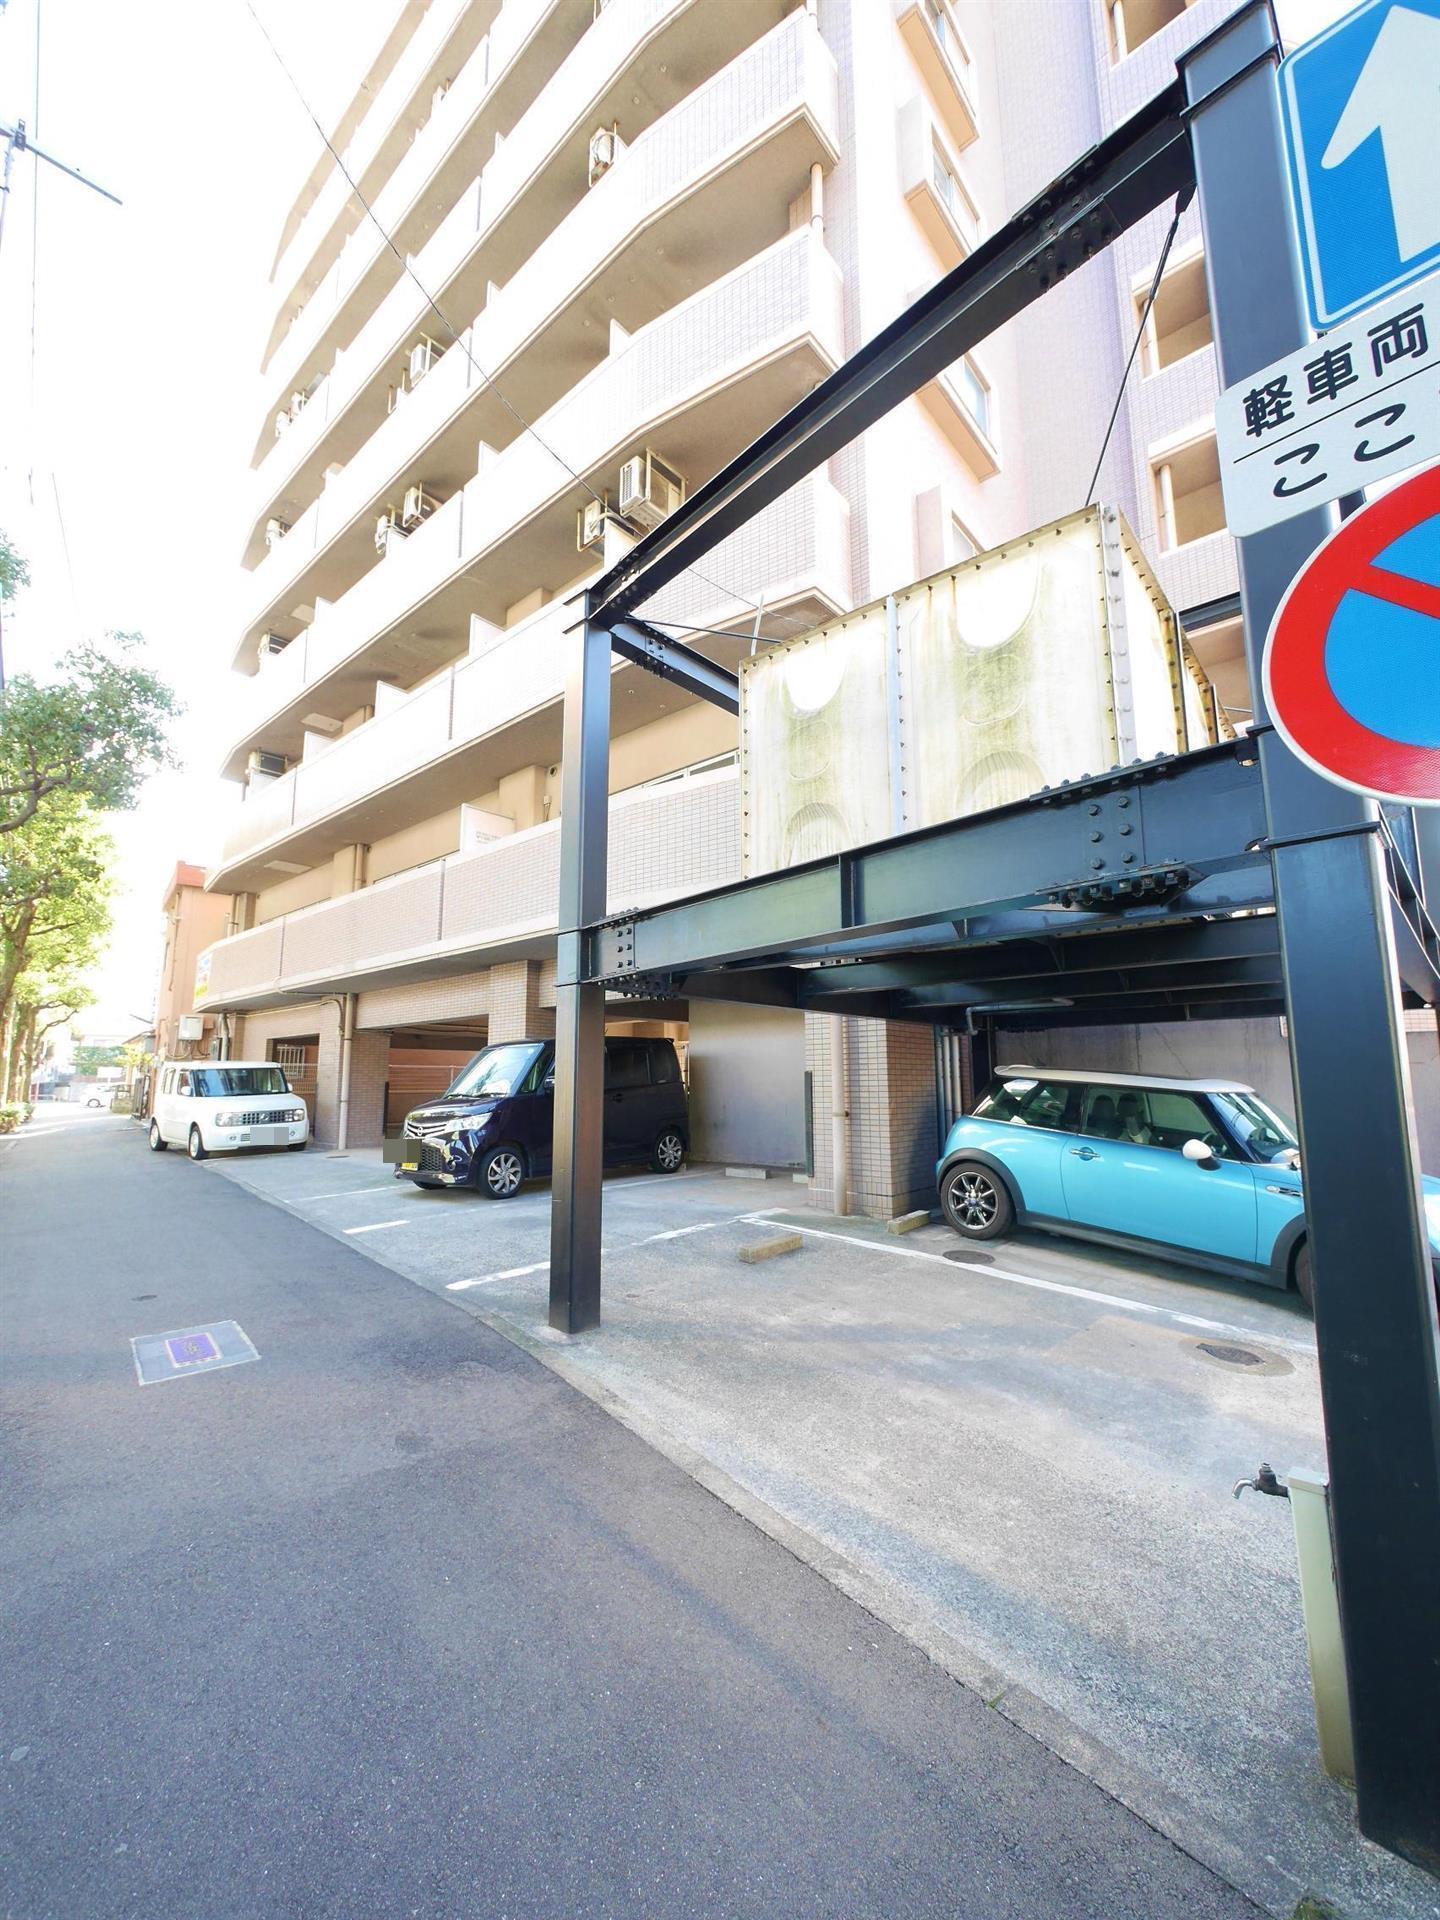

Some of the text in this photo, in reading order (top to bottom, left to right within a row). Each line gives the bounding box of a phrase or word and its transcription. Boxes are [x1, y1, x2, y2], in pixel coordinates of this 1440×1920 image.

[1243, 302, 1429, 437] 軽車両
[1273, 403, 1416, 497] ここ
